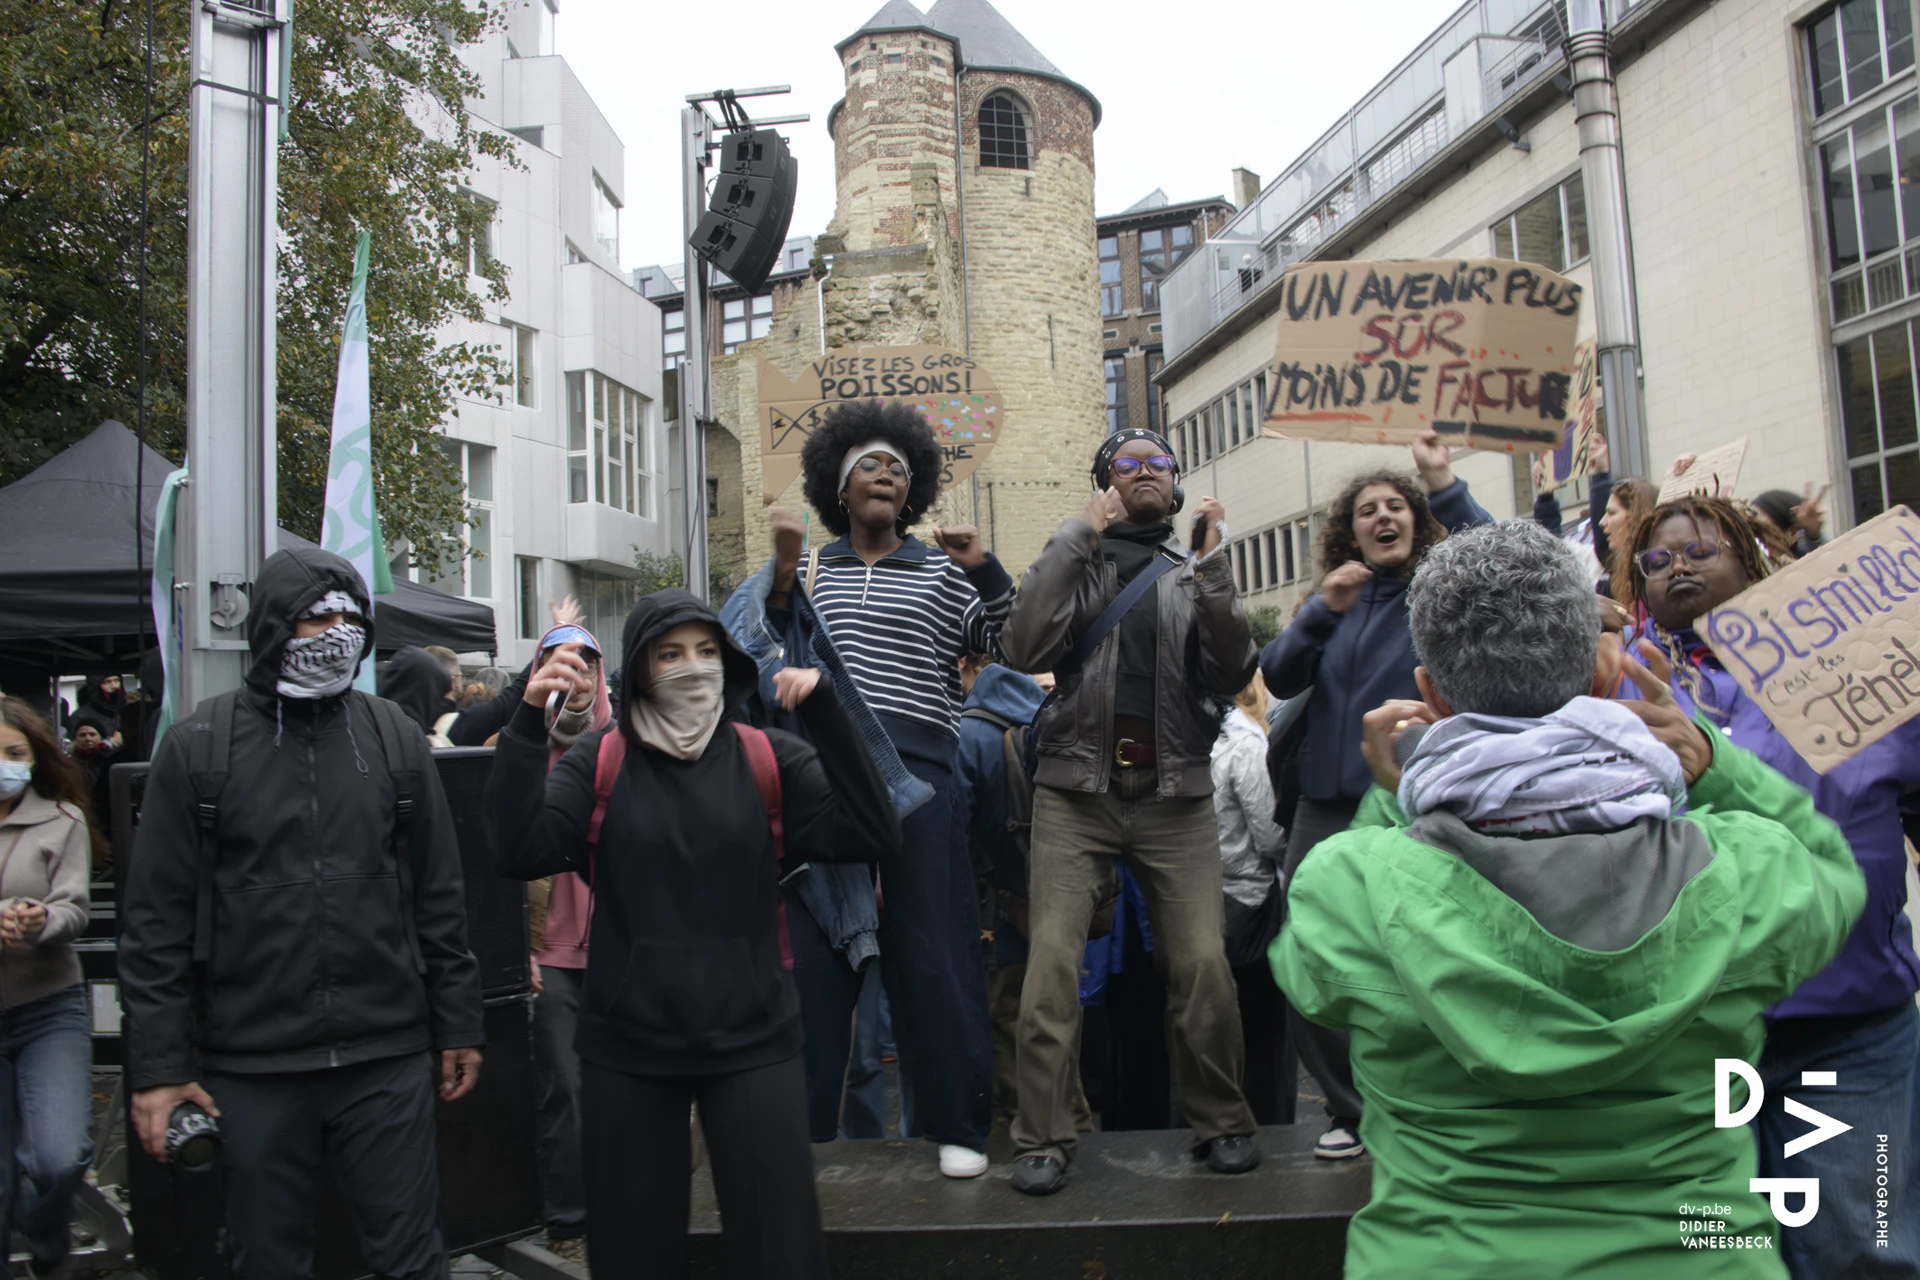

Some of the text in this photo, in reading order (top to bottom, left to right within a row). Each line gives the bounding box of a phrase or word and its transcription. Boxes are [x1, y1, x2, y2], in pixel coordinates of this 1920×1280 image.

[1286, 268, 1349, 321] UN
[1504, 267, 1583, 316] PLUS
[881, 356, 915, 373] LES
[922, 353, 977, 371] GROS
[820, 370, 972, 400] POISSONS!
[1372, 359, 1429, 405] DE
[940, 444, 976, 461] HE
